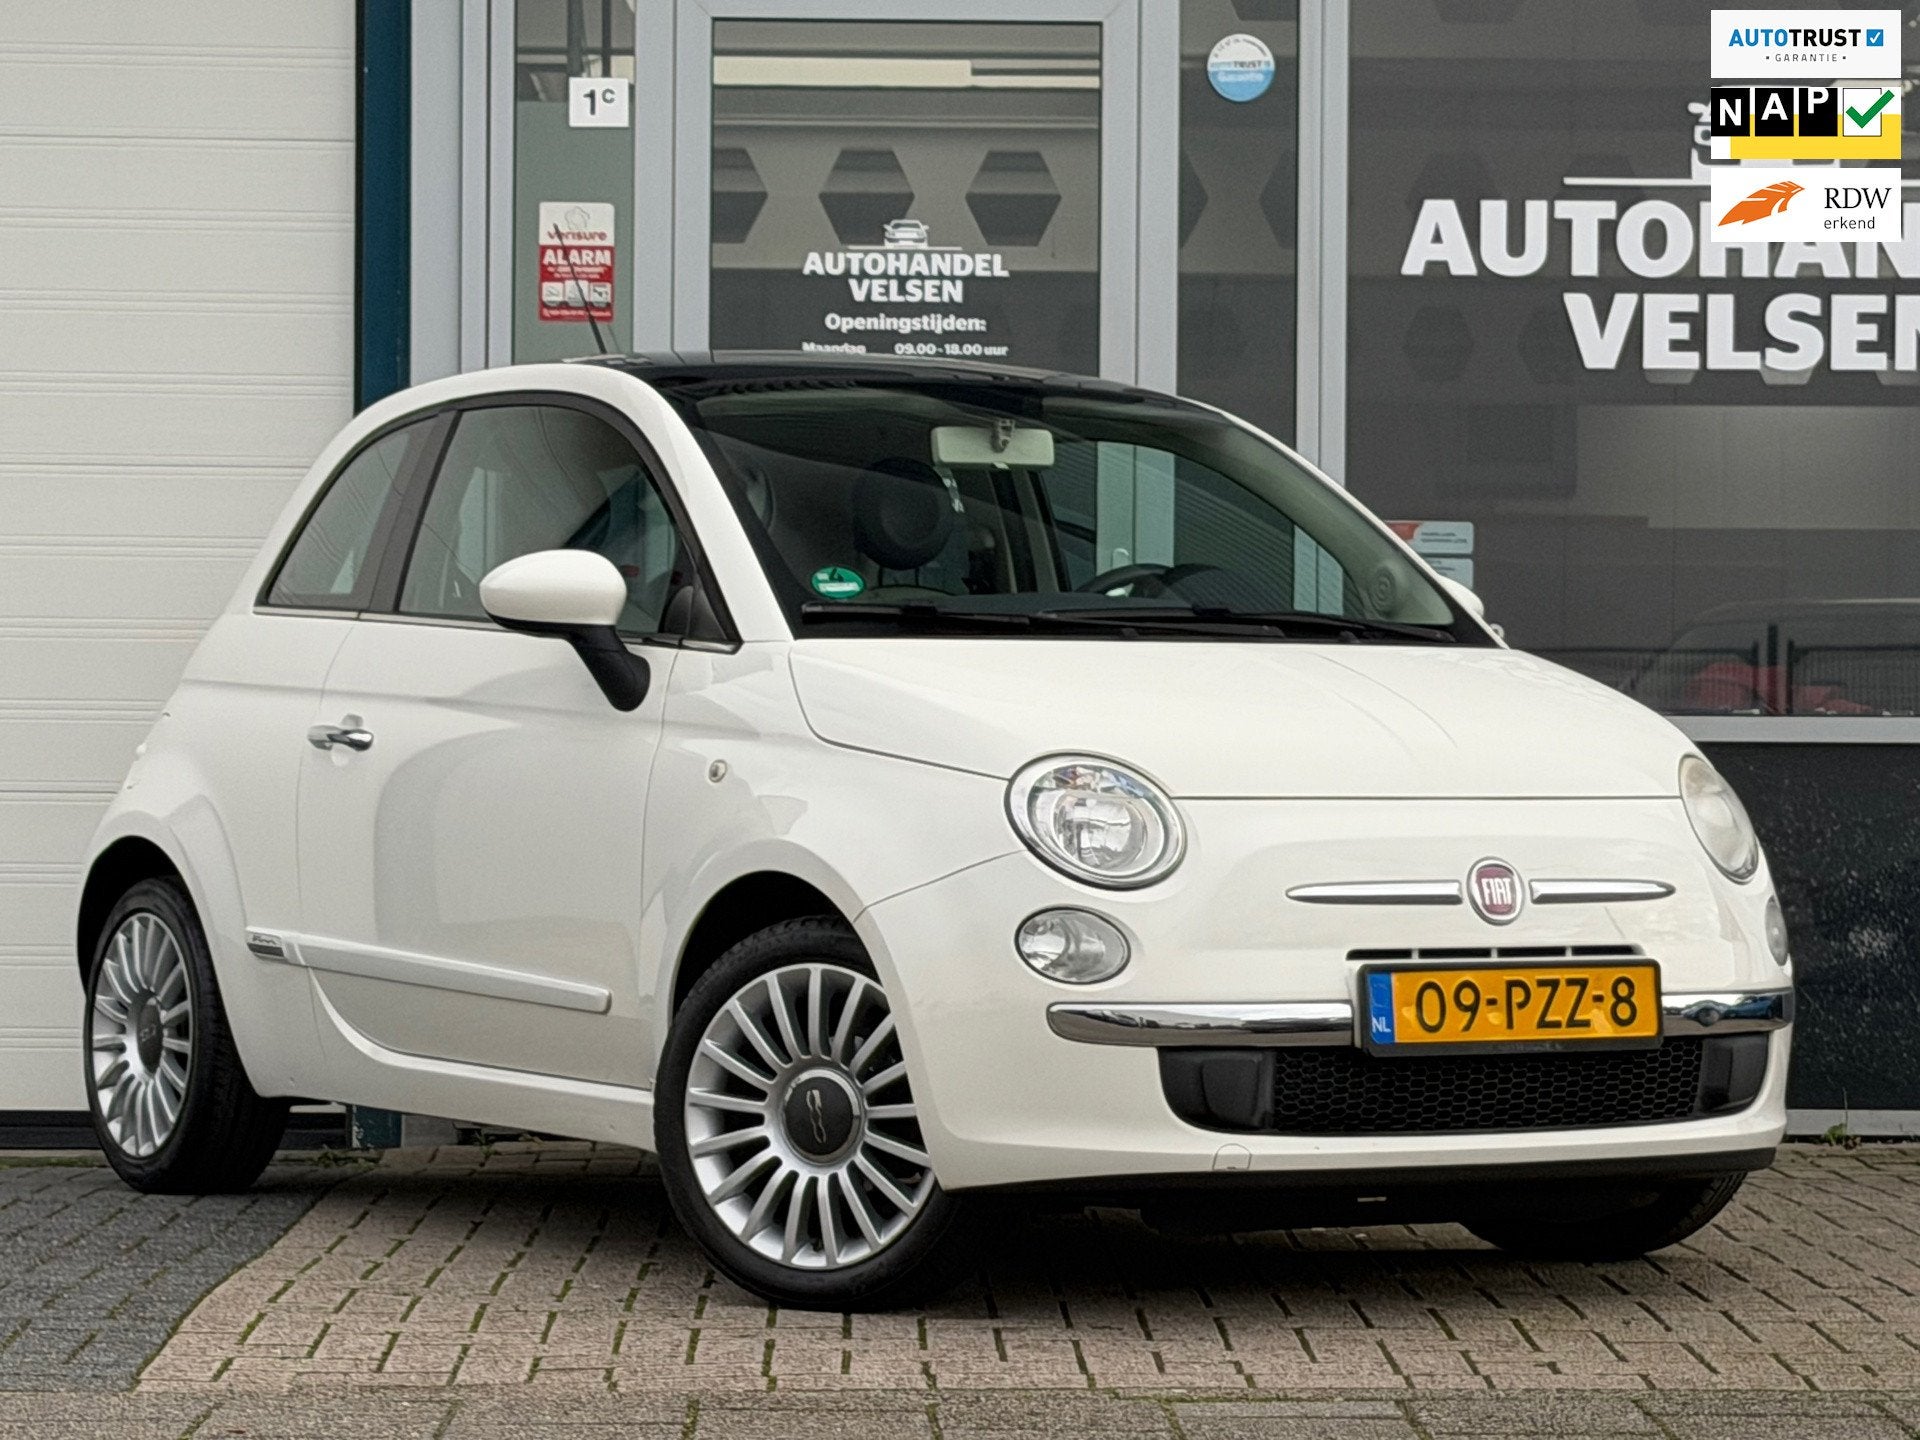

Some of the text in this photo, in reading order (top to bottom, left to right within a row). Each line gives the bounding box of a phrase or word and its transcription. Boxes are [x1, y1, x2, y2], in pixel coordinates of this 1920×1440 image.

[547, 231, 608, 241] vrisure
[543, 248, 612, 267] ALARM
[802, 251, 1010, 278] AUTOHANDEL
[848, 278, 964, 303] VELSEN
[824, 313, 988, 334] Openingstijden:
[1480, 877, 1512, 906] FIAT
[1415, 976, 1637, 1034] 09-PZZ-8
[1371, 1016, 1391, 1033] NL
